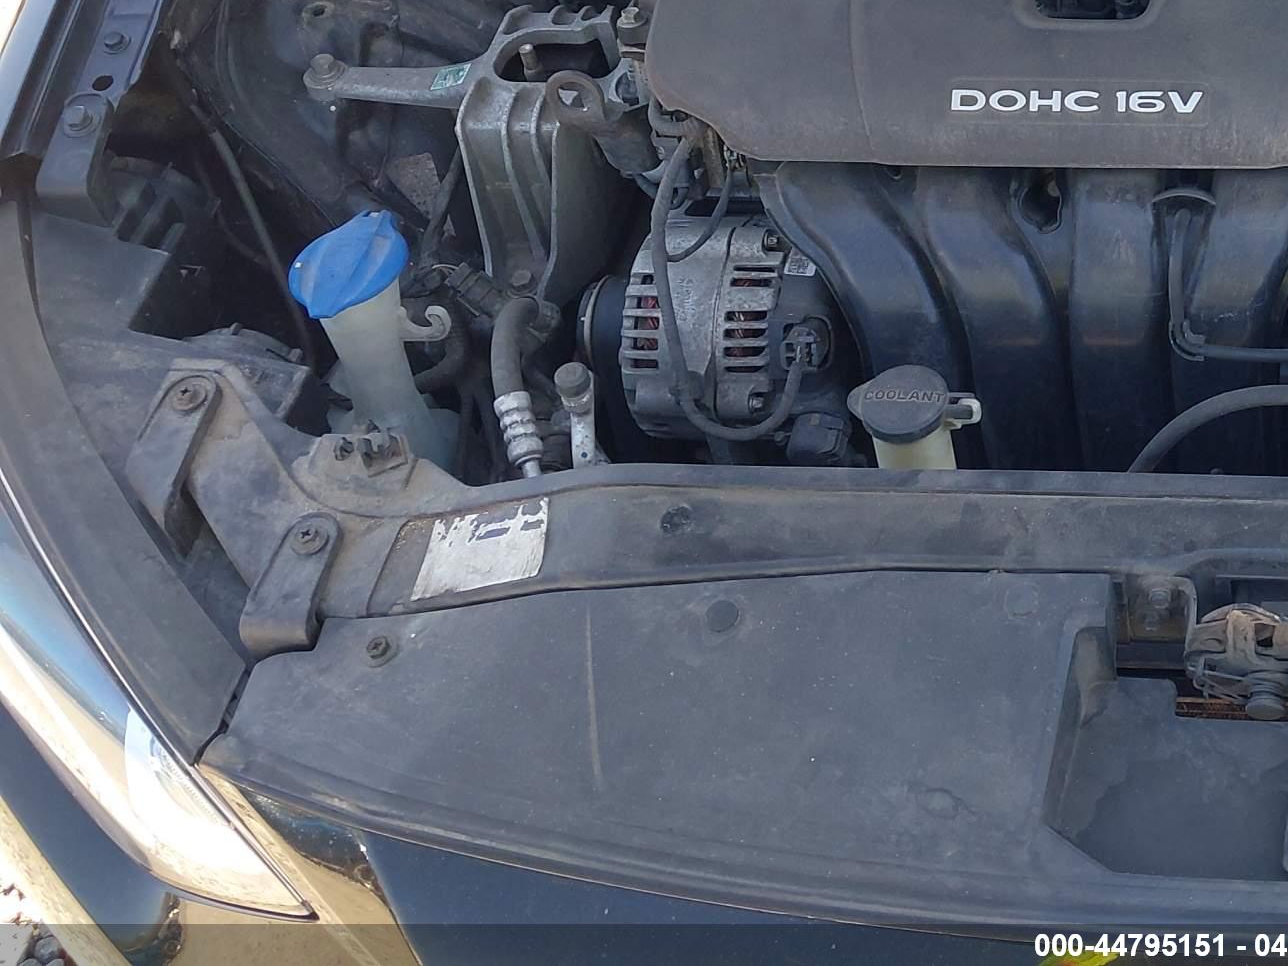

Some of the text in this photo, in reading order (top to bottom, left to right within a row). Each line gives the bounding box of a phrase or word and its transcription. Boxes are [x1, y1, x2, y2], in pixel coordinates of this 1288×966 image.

[951, 89, 1203, 114] DOHC 16V
[864, 389, 945, 403] COOLANT
